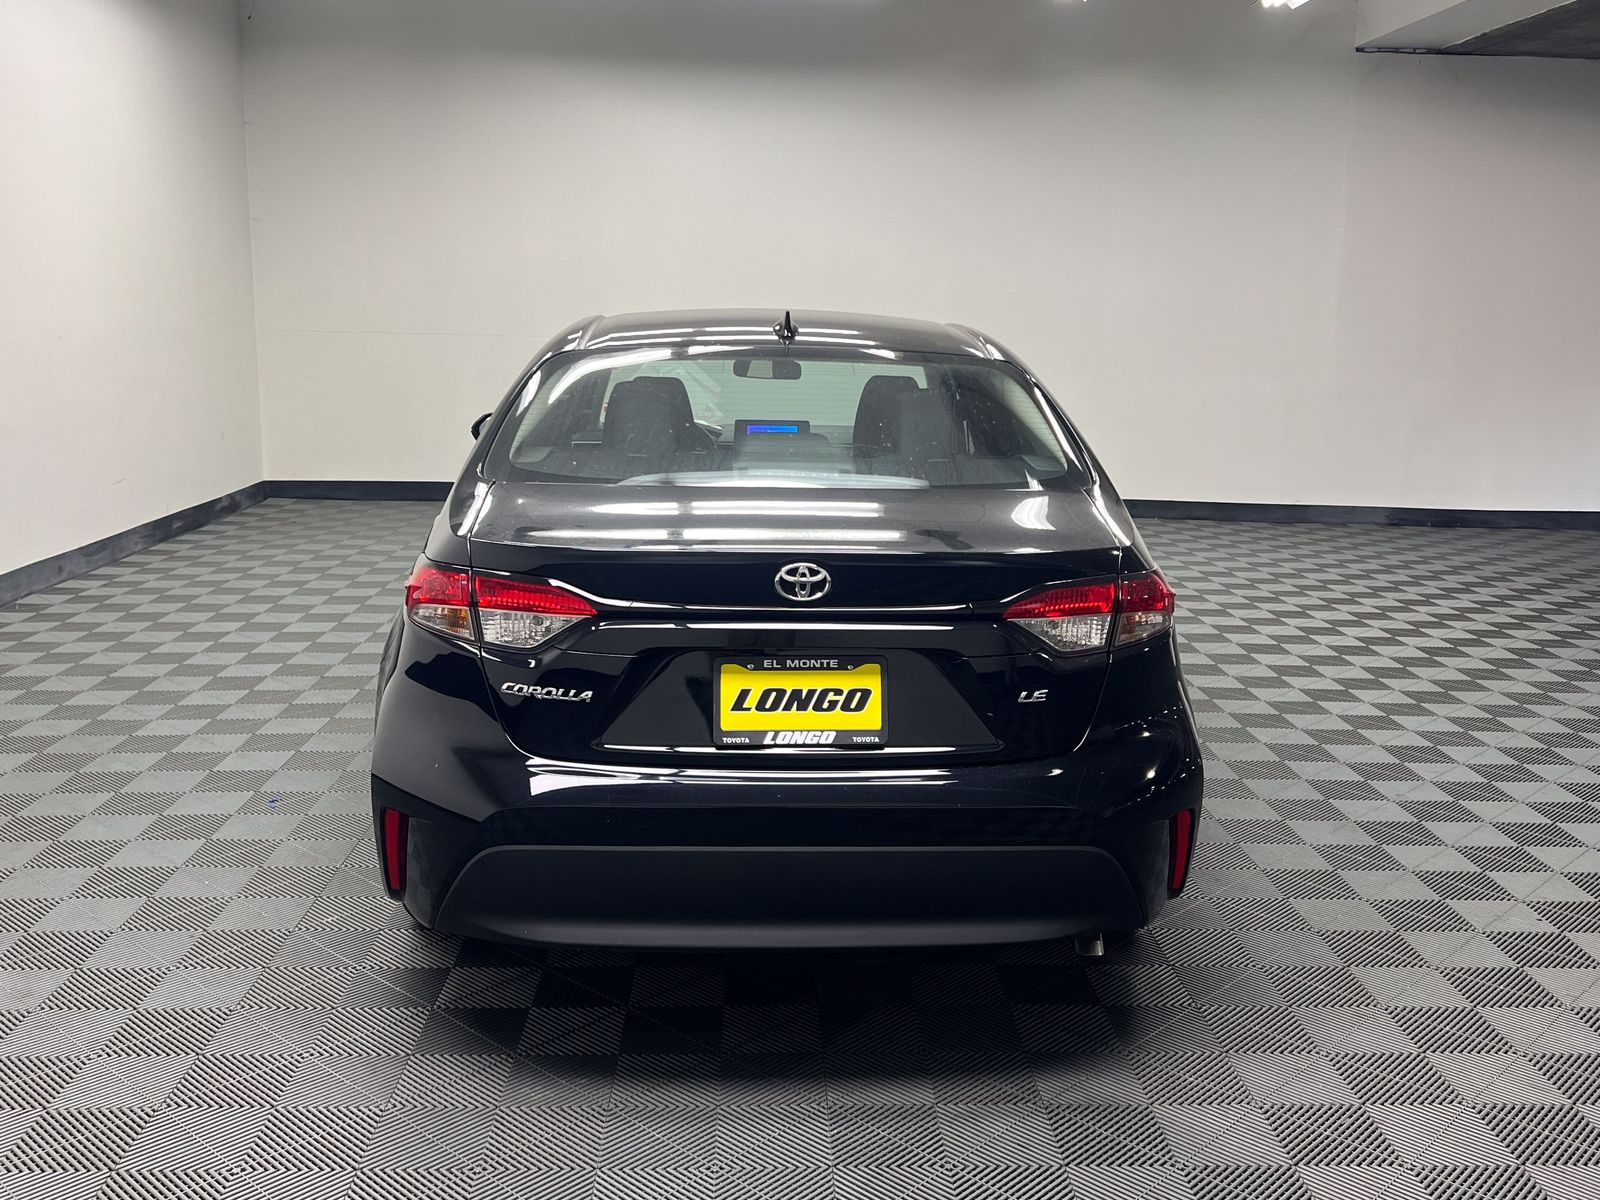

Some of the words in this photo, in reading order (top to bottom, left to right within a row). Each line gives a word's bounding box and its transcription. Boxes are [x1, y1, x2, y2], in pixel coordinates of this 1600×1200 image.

[763, 659, 781, 668] EL
[786, 659, 839, 668] MONTE
[501, 682, 593, 703] COROLLA
[1017, 689, 1049, 703] LE
[730, 688, 873, 713] LONGO
[763, 730, 837, 745] LONGO
